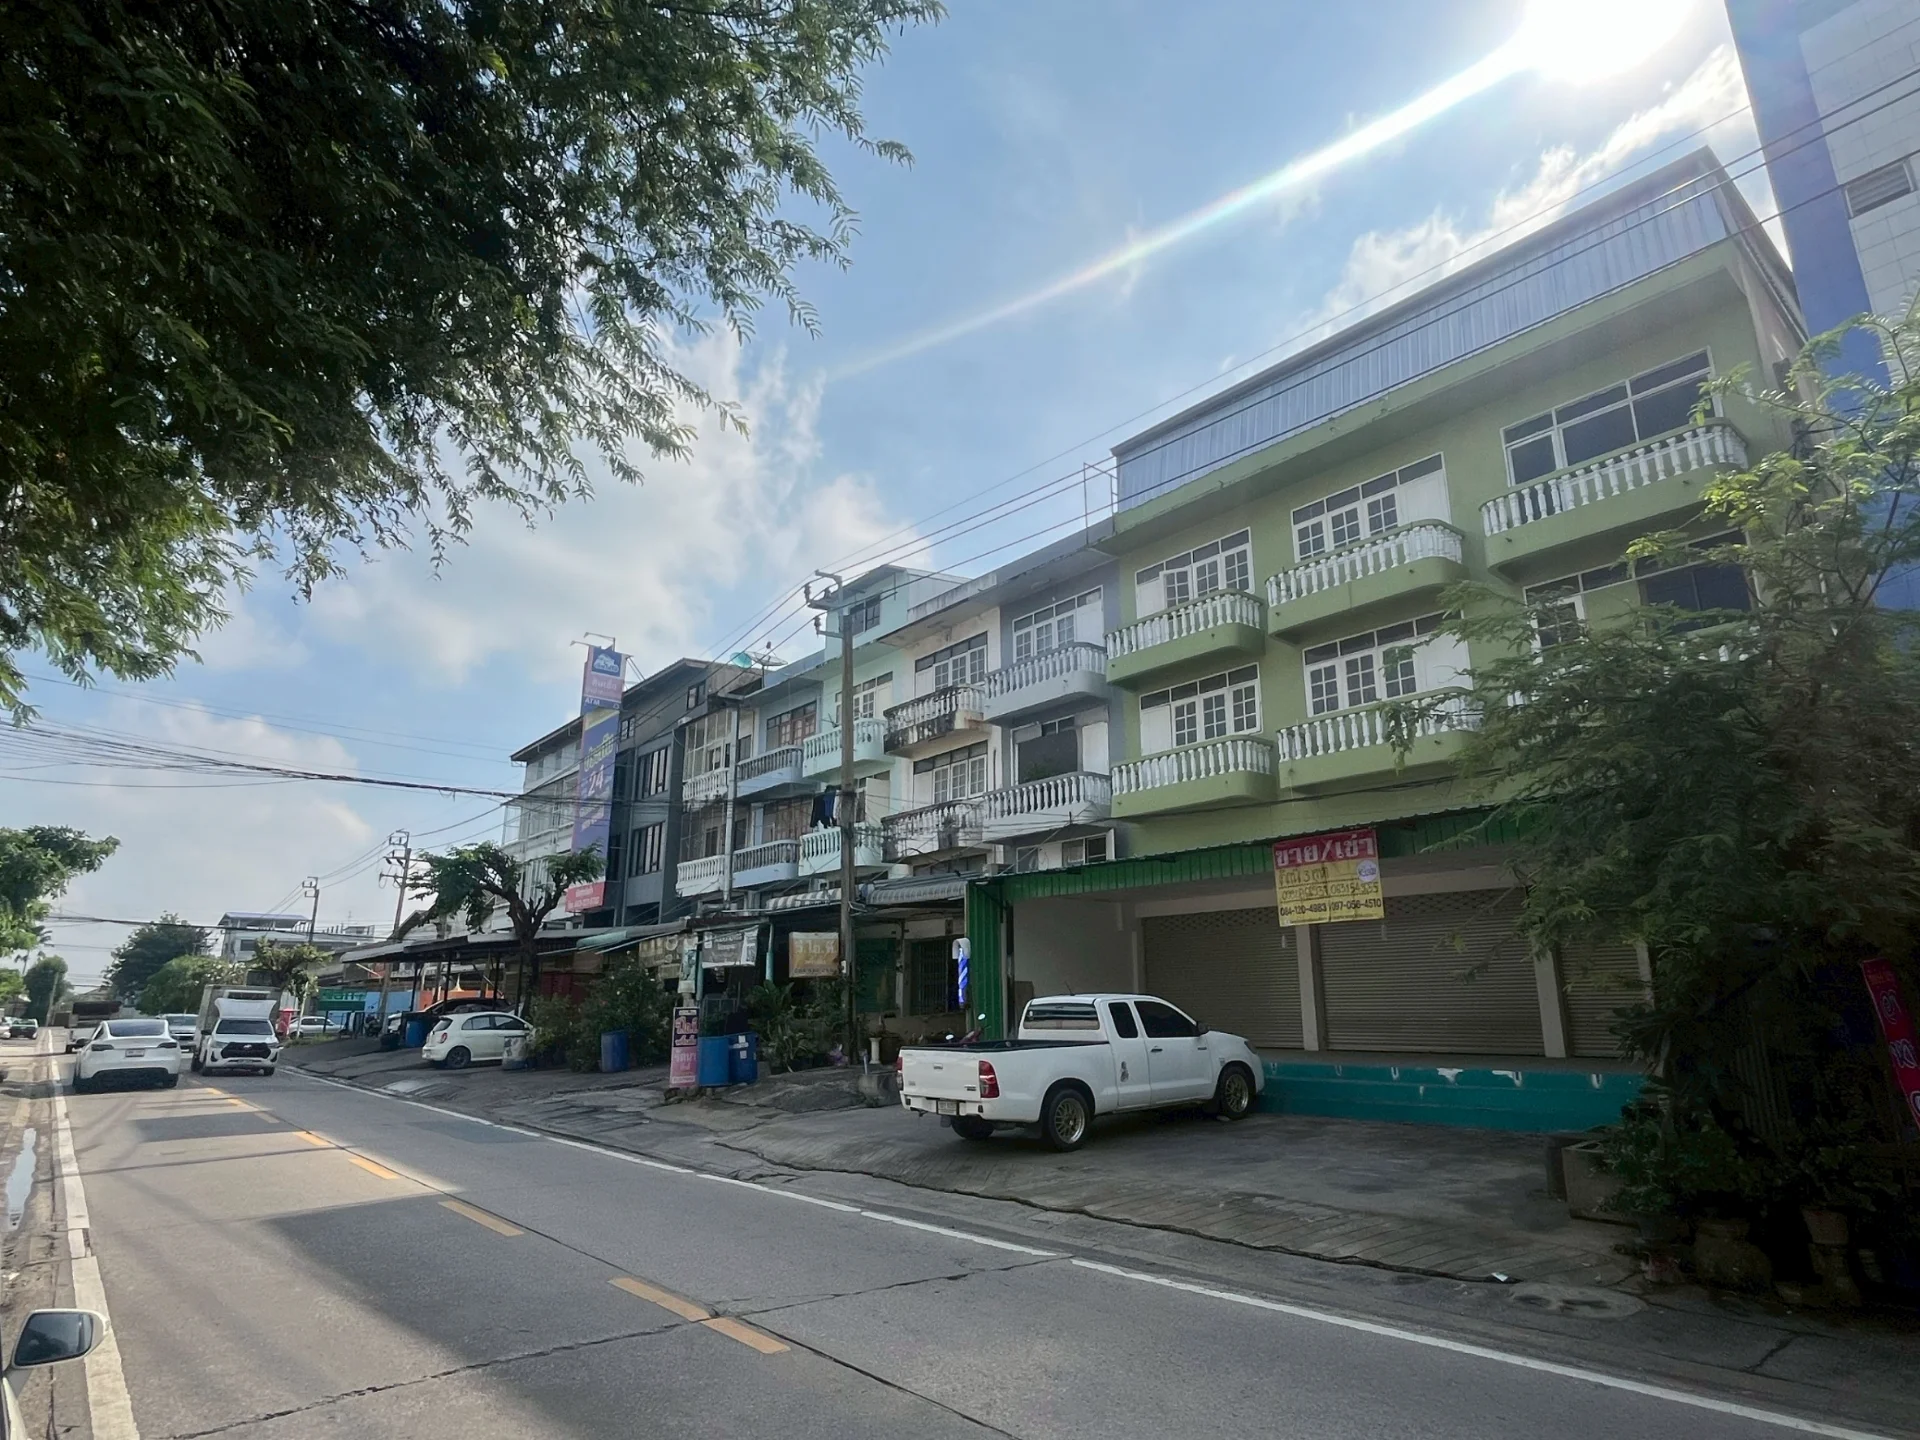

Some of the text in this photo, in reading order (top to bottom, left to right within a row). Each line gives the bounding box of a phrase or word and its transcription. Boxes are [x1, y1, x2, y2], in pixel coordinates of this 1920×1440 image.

[585, 697, 600, 706] ATM
[1275, 833, 1376, 867] ขาย/เช่า
